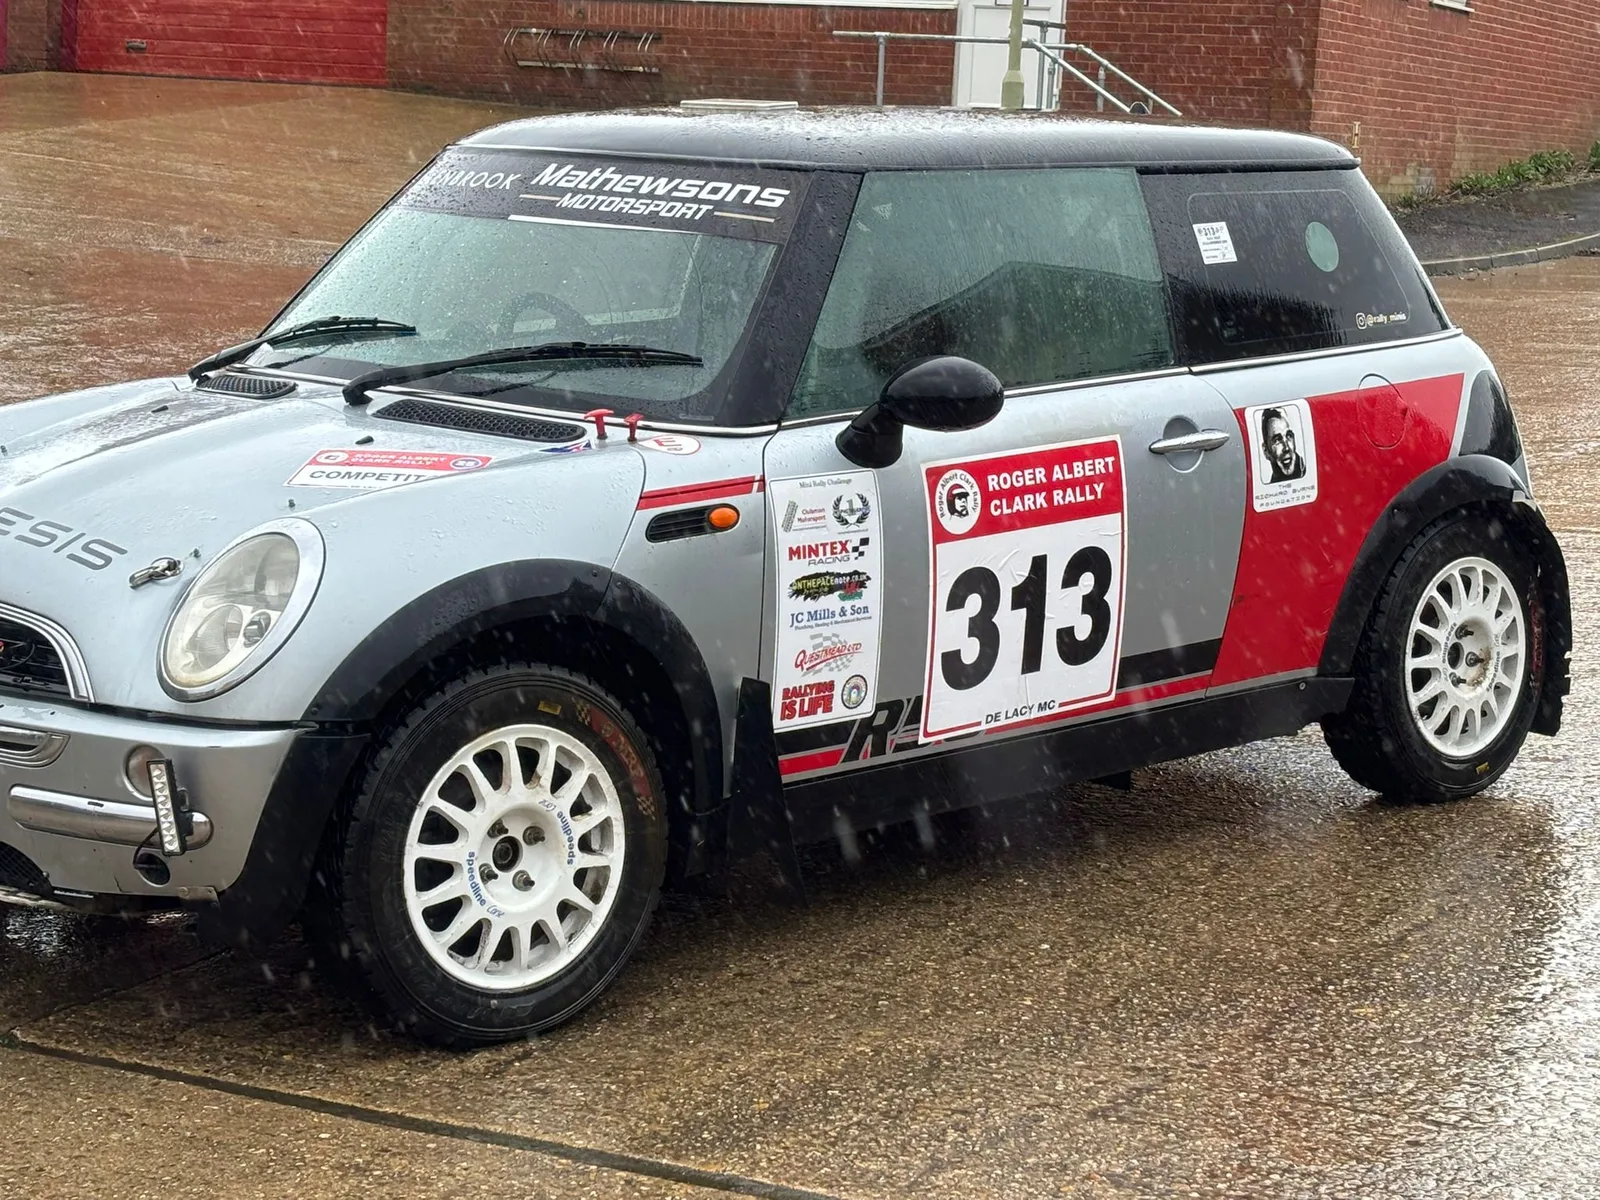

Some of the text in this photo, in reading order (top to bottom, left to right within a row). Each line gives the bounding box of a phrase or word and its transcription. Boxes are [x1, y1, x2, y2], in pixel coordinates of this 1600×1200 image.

[530, 163, 791, 207] Mathewsons
[556, 192, 716, 220] MOTORSPORT
[1202, 227, 1216, 237] 313
[987, 456, 1116, 491] ROGER ALBERT
[938, 491, 946, 518] Roger
[959, 473, 975, 490] Clark
[990, 483, 1104, 516] CLARK RALLY
[788, 541, 851, 561] MINTEX
[808, 555, 850, 566] RACING
[790, 604, 869, 628] JC Mills & Son
[940, 545, 1112, 691] 313
[782, 680, 835, 700] RALLYING
[780, 693, 834, 721] IS LIFE
[985, 699, 1056, 724] DE LACY MC
[555, 811, 576, 865] speedline
[466, 851, 487, 906] speedline
